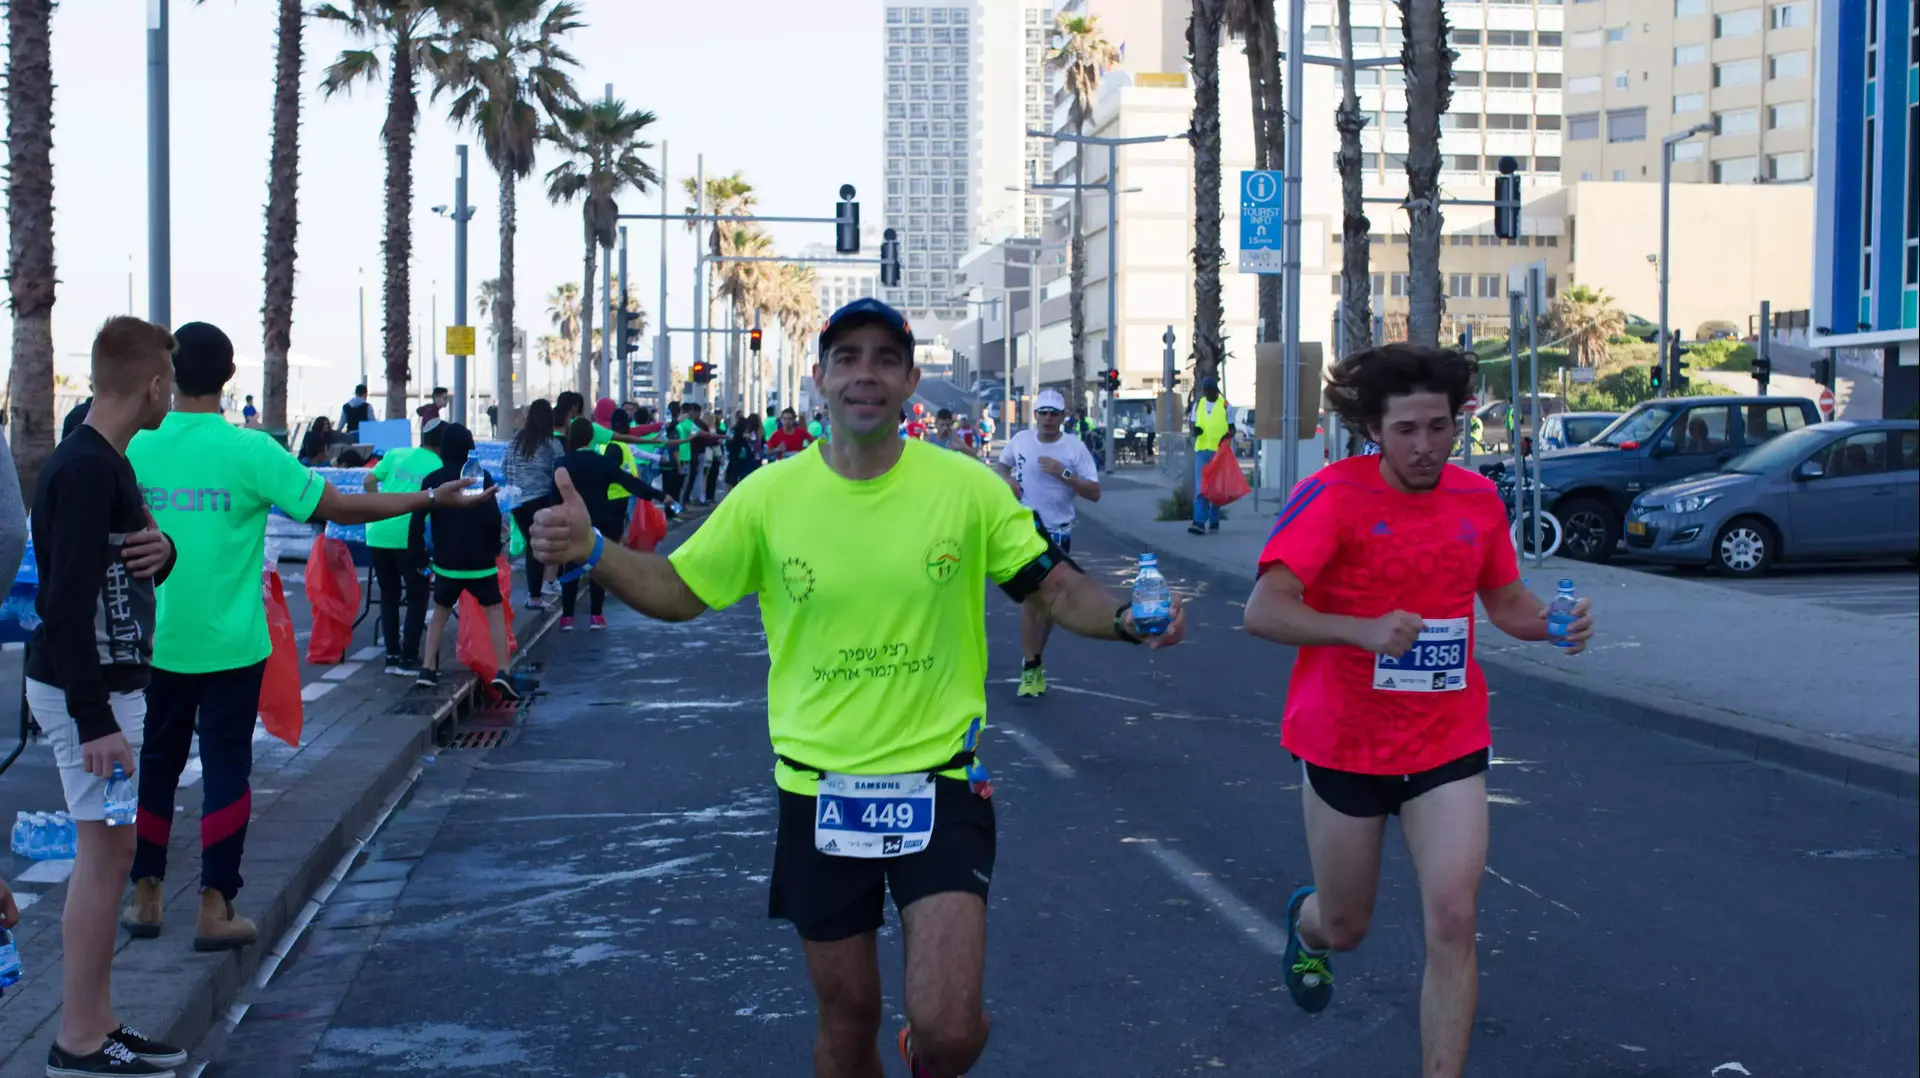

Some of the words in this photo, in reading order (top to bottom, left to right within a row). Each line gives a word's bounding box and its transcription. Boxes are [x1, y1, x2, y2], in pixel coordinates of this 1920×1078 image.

[1243, 207, 1280, 217] TOURIST
[1250, 216, 1272, 225] INFO
[106, 561, 131, 621] EVER
[838, 647, 877, 662] שפיר
[1412, 644, 1461, 667] 1358
[864, 664, 898, 678] תמר
[854, 781, 901, 790] SAMSUNG
[820, 800, 841, 825] A
[861, 802, 914, 829] 449
